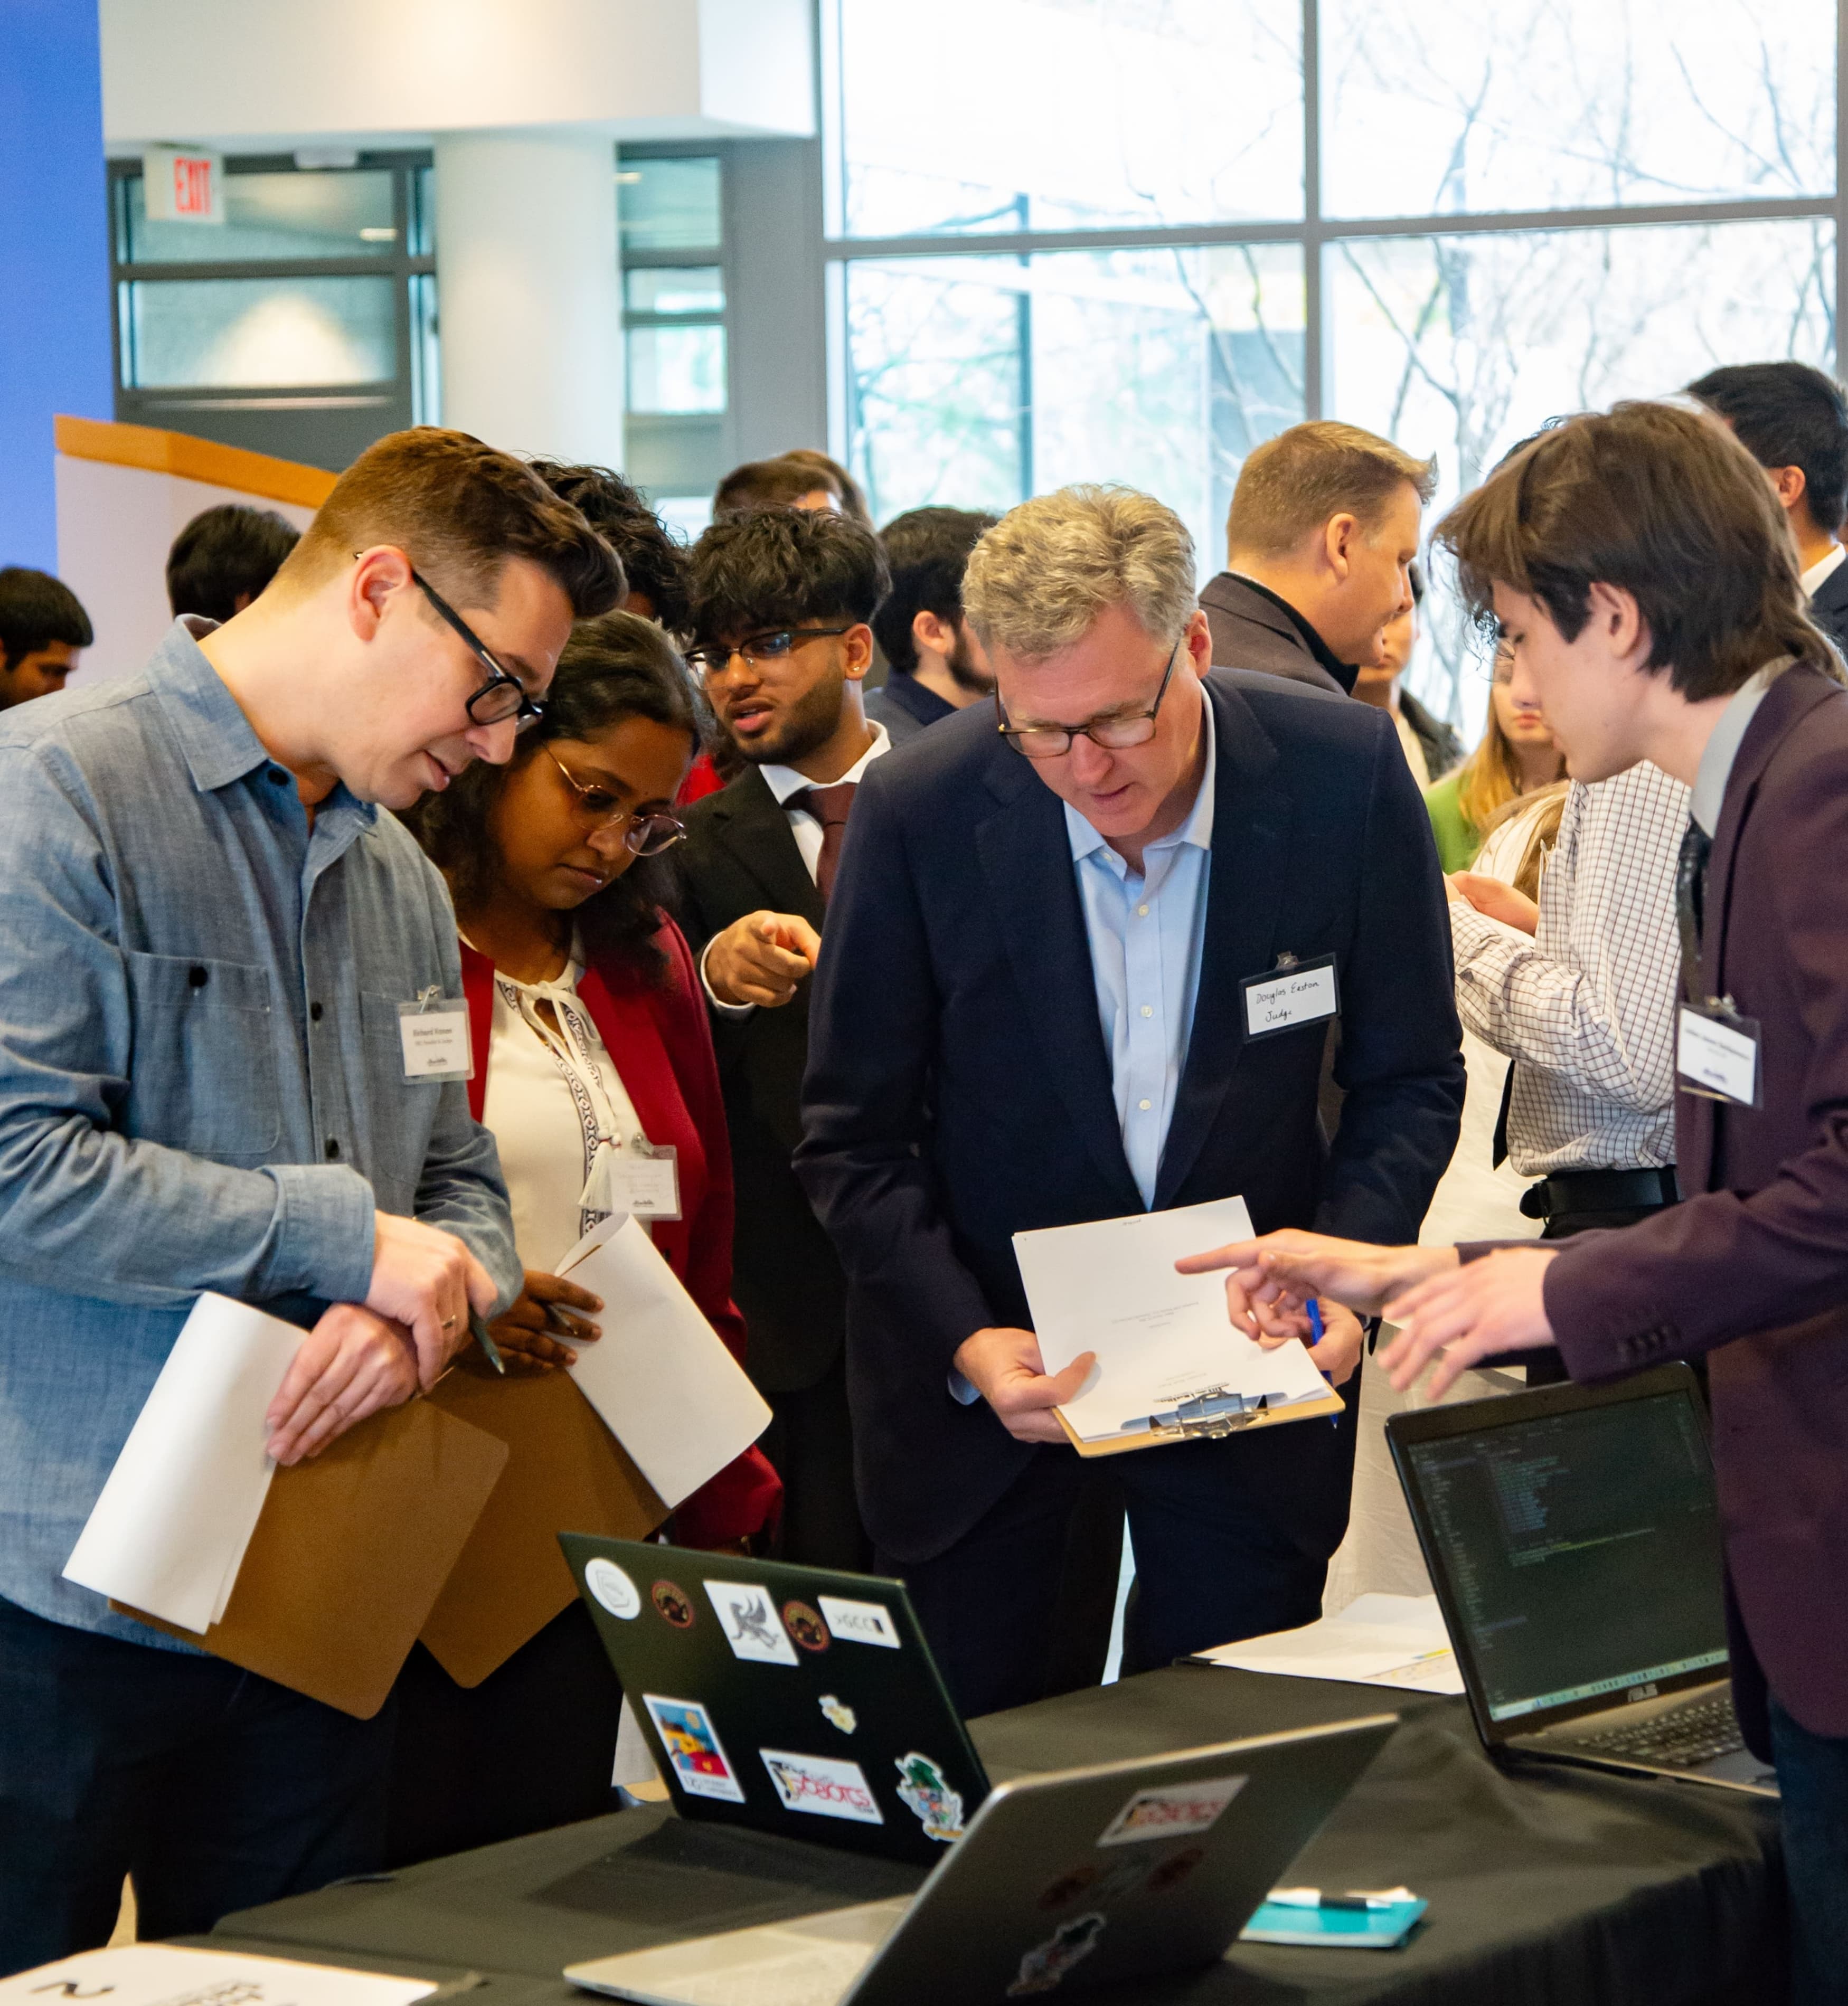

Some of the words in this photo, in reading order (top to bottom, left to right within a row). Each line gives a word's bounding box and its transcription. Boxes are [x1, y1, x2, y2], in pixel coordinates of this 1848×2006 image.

[174, 157, 211, 214] EXIT
[1256, 988, 1286, 1005] Douglas
[1266, 1009, 1293, 1022] Judge
